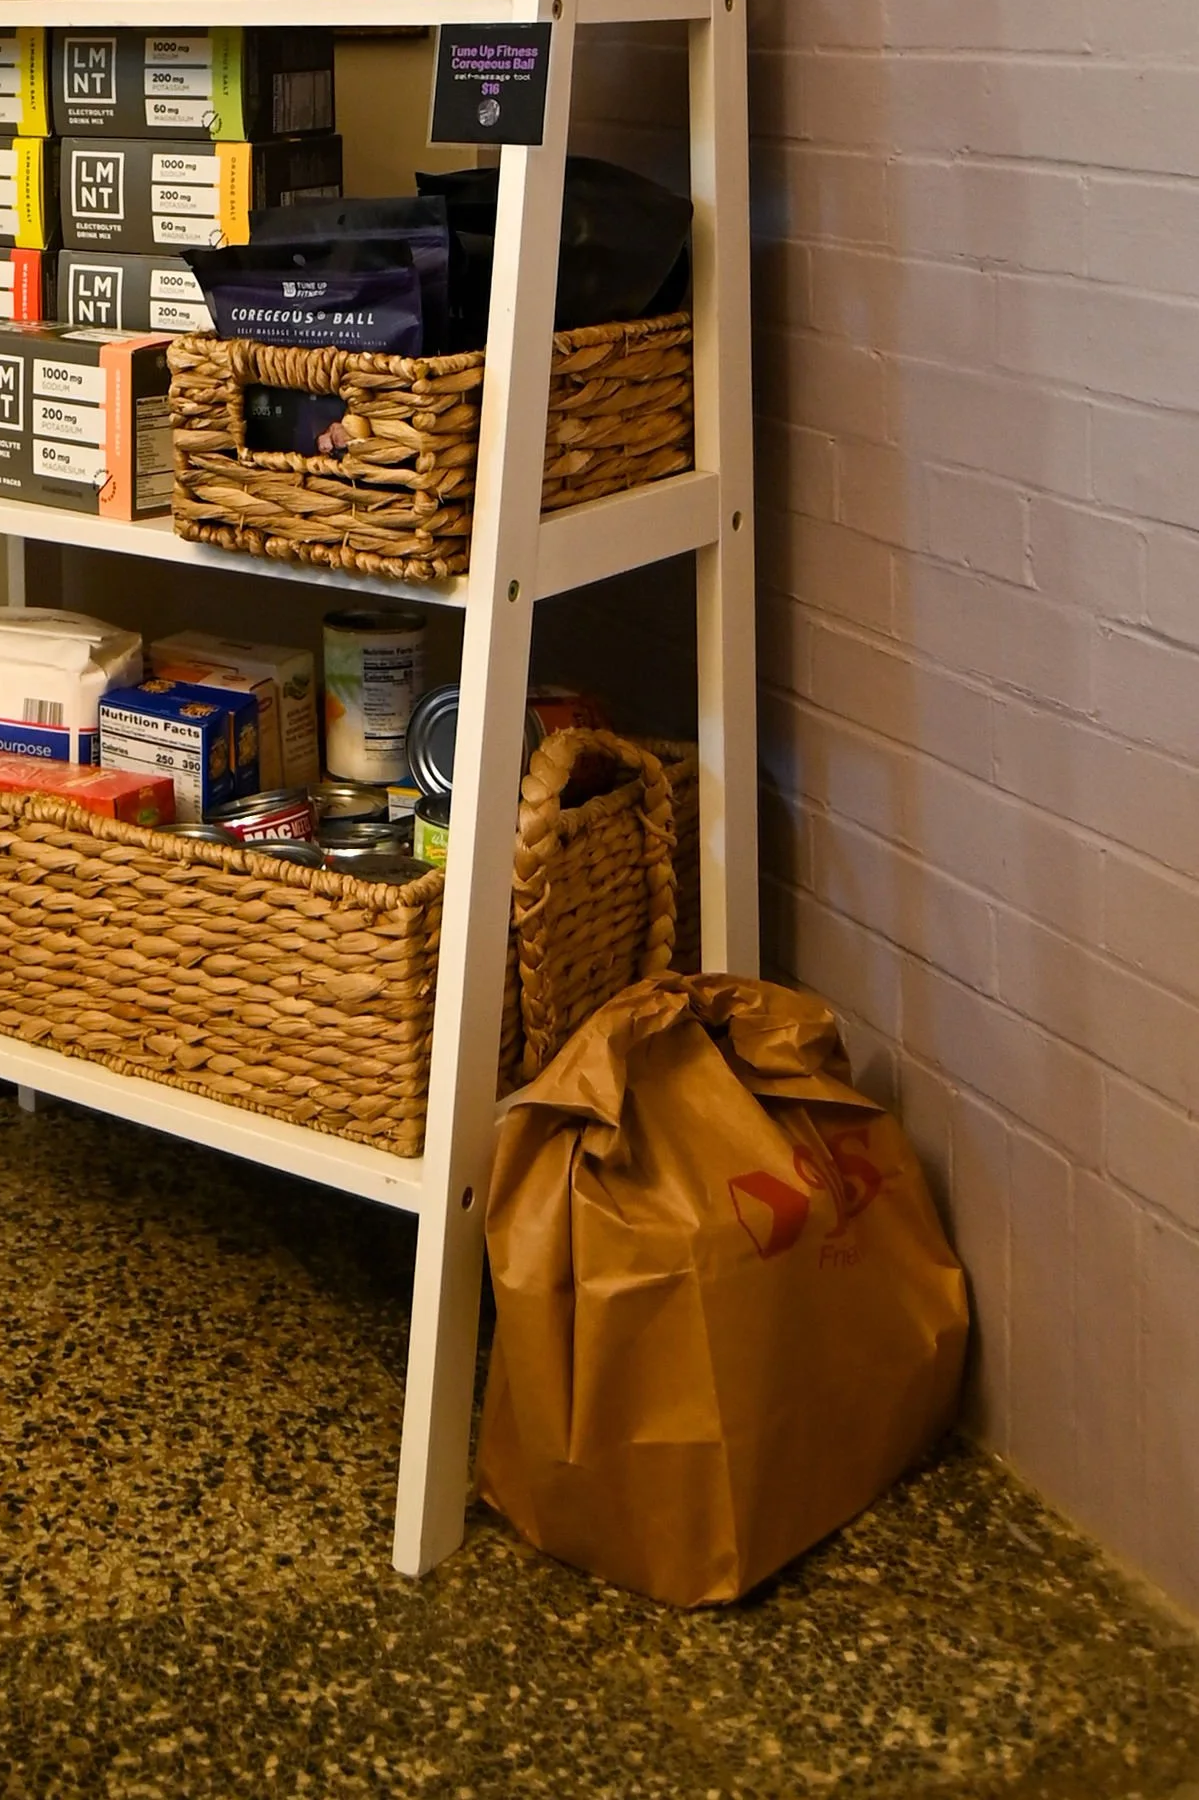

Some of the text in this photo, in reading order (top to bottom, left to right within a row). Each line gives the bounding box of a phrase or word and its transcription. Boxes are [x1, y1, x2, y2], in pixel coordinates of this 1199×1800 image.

[153, 42, 190, 53] 1000 mg
[451, 45, 538, 58] Tune Up Fitness
[74, 47, 105, 68] LM
[451, 58, 535, 71] Coregeous Ball
[74, 72, 105, 94] NT
[152, 73, 184, 84] 200 mg
[454, 73, 511, 81] self-massage
[481, 82, 500, 95] $16
[68, 108, 114, 117] ELECTROLYTE
[153, 104, 179, 115] 60 mg
[91, 117, 104, 125] MIX
[81, 161, 114, 183] LM
[161, 160, 197, 171] 1000 mg
[81, 187, 113, 209] NT
[159, 191, 191, 202] 200 mg
[76, 222, 122, 232] ELECTROLYTE
[161, 222, 186, 233] 60 mg
[99, 232, 112, 240] MIX
[79, 274, 112, 297] LM
[160, 276, 196, 288] 1000 mg
[296, 282, 328, 290] TUNE UP
[78, 300, 111, 323] NT
[158, 307, 190, 320] 200 mg
[333, 312, 375, 325] BALL
[237, 327, 361, 338] SELF MASSAGE THERAPY BALL
[42, 367, 83, 385] 1000 mg
[41, 381, 71, 393] SODIUM
[42, 407, 77, 424] 200 mg
[41, 420, 83, 435] POTASSIUM
[42, 447, 70, 464] 60 mg
[42, 463, 86, 476] MAGNESIUM
[101, 707, 159, 730] Nutrition
[163, 722, 200, 739] Facts
[102, 742, 129, 755] Calories
[156, 754, 200, 772] 250 390
[243, 824, 293, 842] MAC
